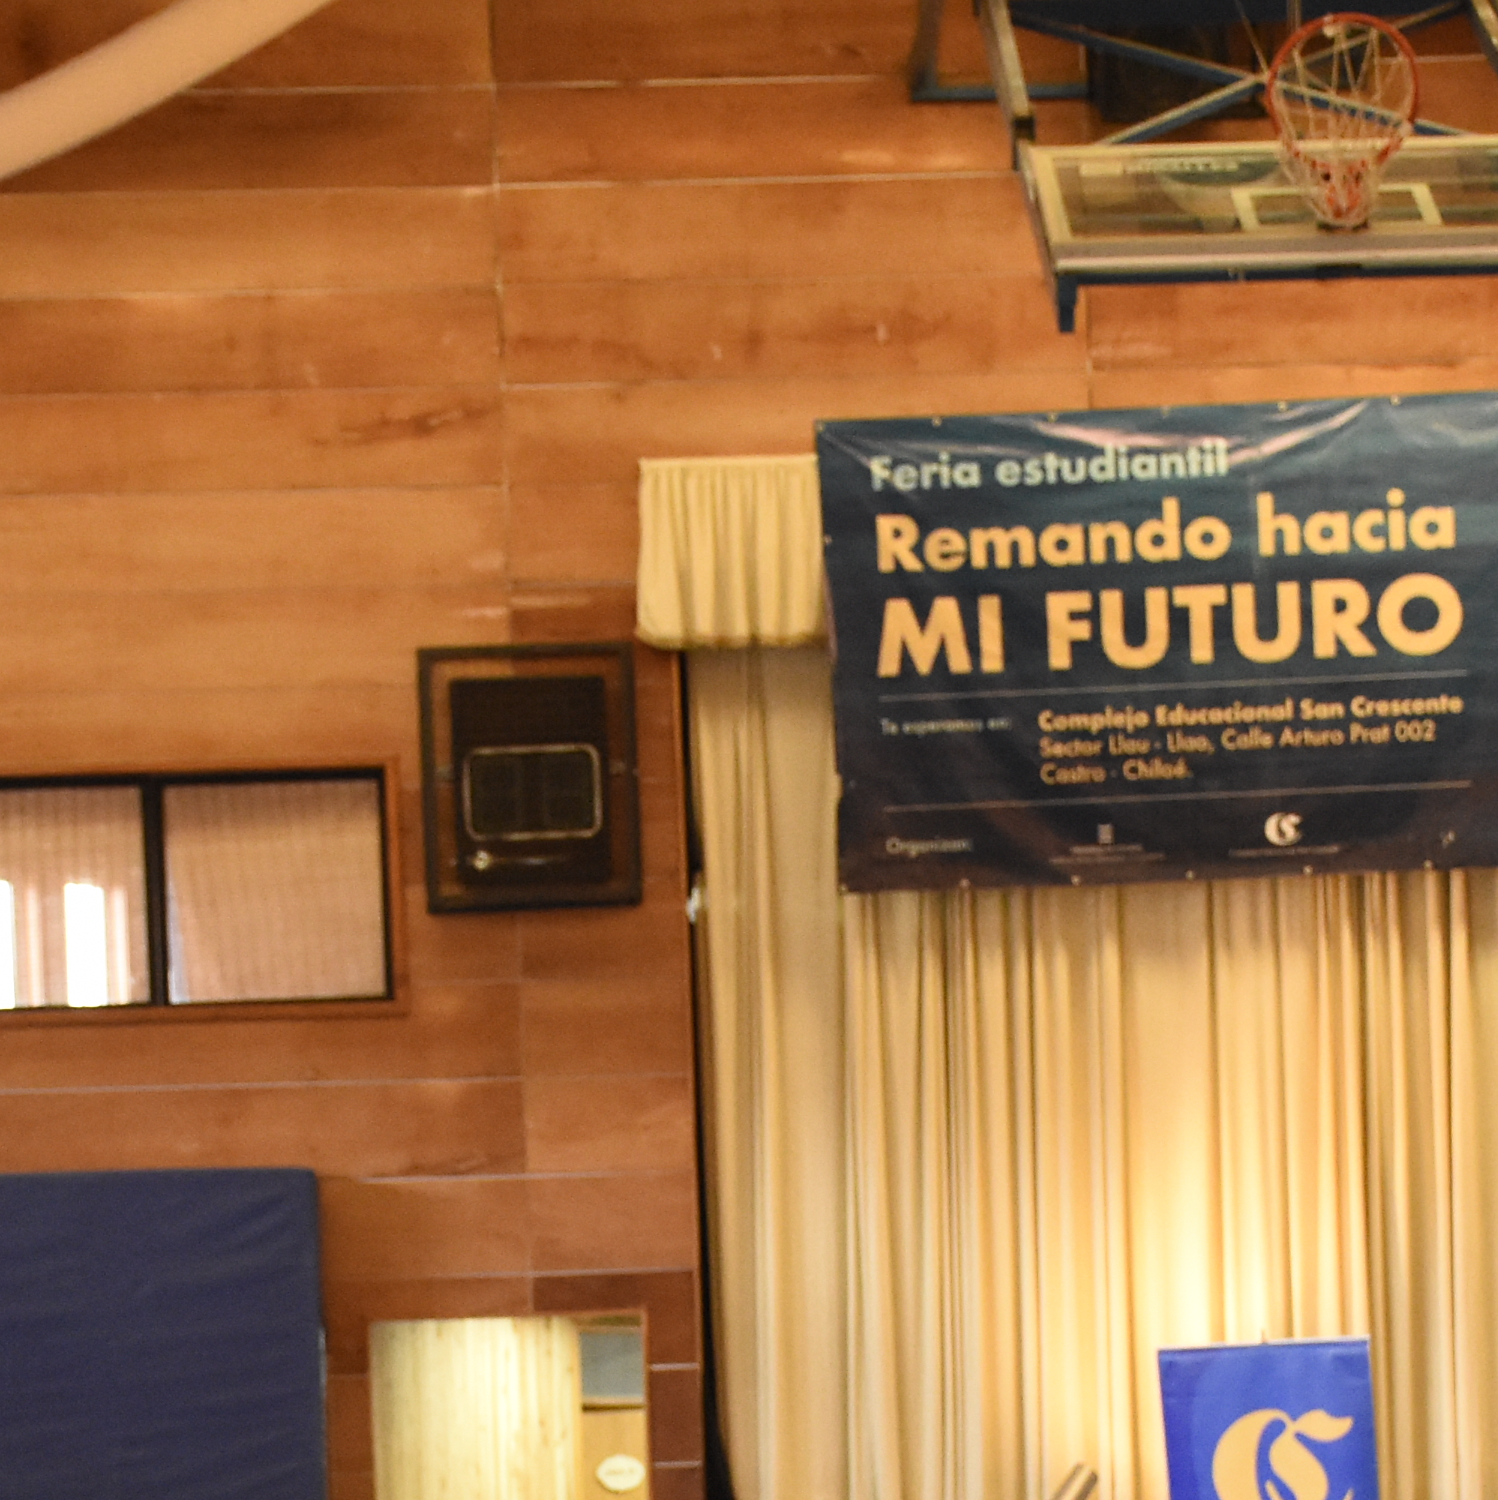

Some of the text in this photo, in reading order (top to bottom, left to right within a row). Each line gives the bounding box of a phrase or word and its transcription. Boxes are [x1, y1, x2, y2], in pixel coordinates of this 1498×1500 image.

[870, 439, 1231, 492] Feria estudiantil
[875, 487, 1457, 574] Remando hacia
[876, 571, 1464, 679] MI FUTURO
[1037, 693, 1465, 734] Complejo Educacional San Crescente
[1038, 735, 1104, 758] Sector
[1220, 724, 1276, 752] Calle
[1279, 724, 1347, 749] Arturo
[1349, 720, 1392, 745] Prat
[1394, 717, 1437, 744] 002
[1039, 761, 1107, 786] Castro
